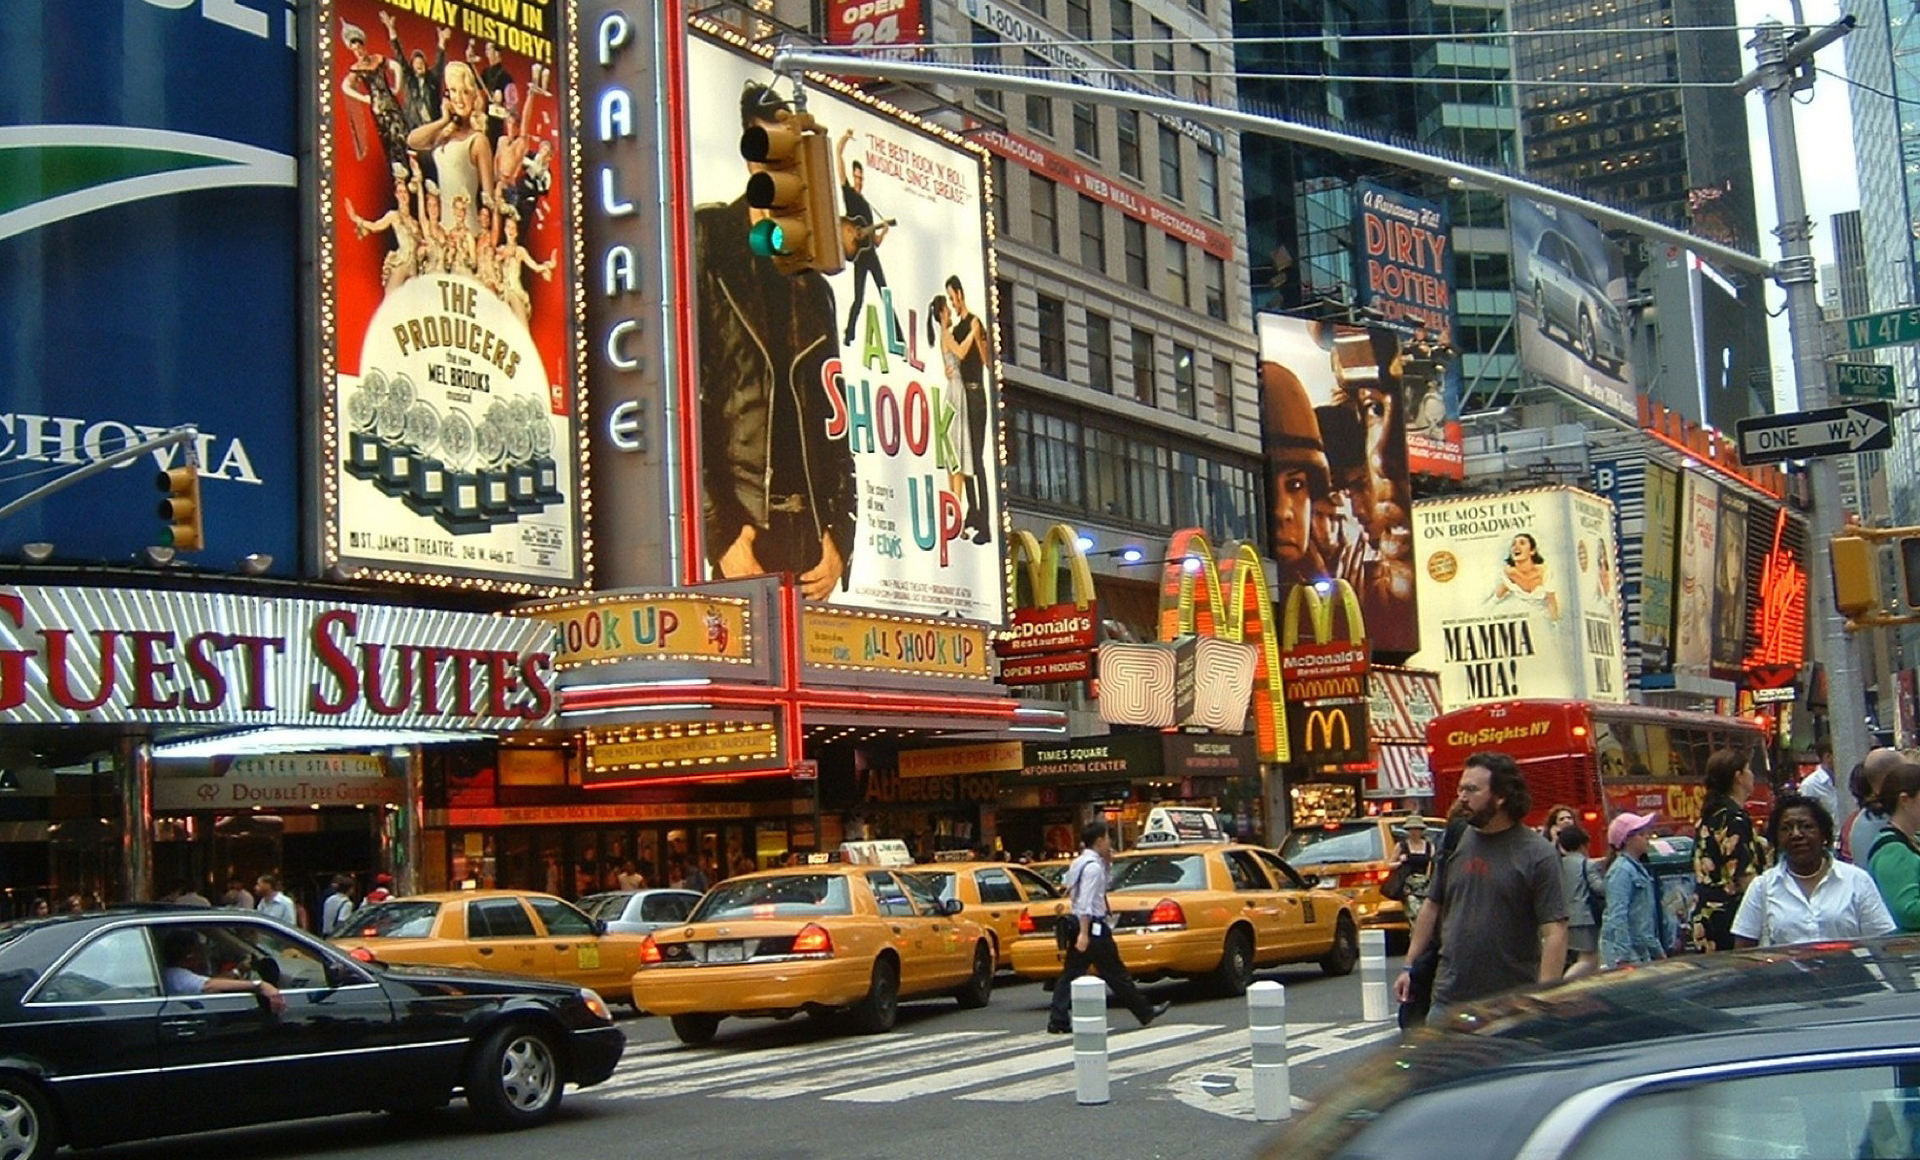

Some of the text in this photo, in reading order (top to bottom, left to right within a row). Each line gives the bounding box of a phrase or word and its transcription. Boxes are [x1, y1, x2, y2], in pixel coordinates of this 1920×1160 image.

[523, 3, 543, 31] IN
[842, 0, 905, 24] OPEN
[462, 8, 552, 64] HISTORY!
[851, 14, 900, 52] 24
[600, 14, 639, 454] PALACE
[1364, 211, 1446, 274] DIRTY
[437, 280, 478, 319] THE
[1368, 259, 1450, 311] ROTTEN
[862, 286, 925, 374] ALL
[1854, 319, 1870, 347] W
[1879, 313, 1901, 342] 47
[393, 315, 522, 379] PRODUCERS
[428, 362, 491, 394] MEL BROOKS
[821, 357, 961, 475] SHOOK
[1758, 417, 1871, 449] ONE WAY
[908, 473, 963, 567] UP
[1456, 504, 1494, 521] MOST
[1502, 500, 1531, 515] FUN
[376, 534, 410, 554] JAMES
[1424, 525, 1445, 540] ON
[632, 605, 680, 649] UP
[1012, 617, 1091, 639] cDonald's
[1012, 634, 1075, 649] Restaurant
[1443, 619, 1535, 664] MAMMA
[864, 626, 889, 661] ALL
[895, 629, 947, 666] SHOOK
[952, 633, 973, 668] UP
[1283, 650, 1364, 669] McDonald's
[310, 609, 552, 720] SUITES
[1003, 661, 1086, 678] OPEN 24 HOURS
[1297, 664, 1351, 677] Restaurant
[1465, 660, 1518, 700] MIA!
[1447, 720, 1550, 747] CitySights NY
[233, 760, 295, 773] CENTER
[306, 758, 347, 772] STAGE
[1037, 746, 1109, 762] TIMES SQUARE
[1087, 759, 1128, 772] CENTER
